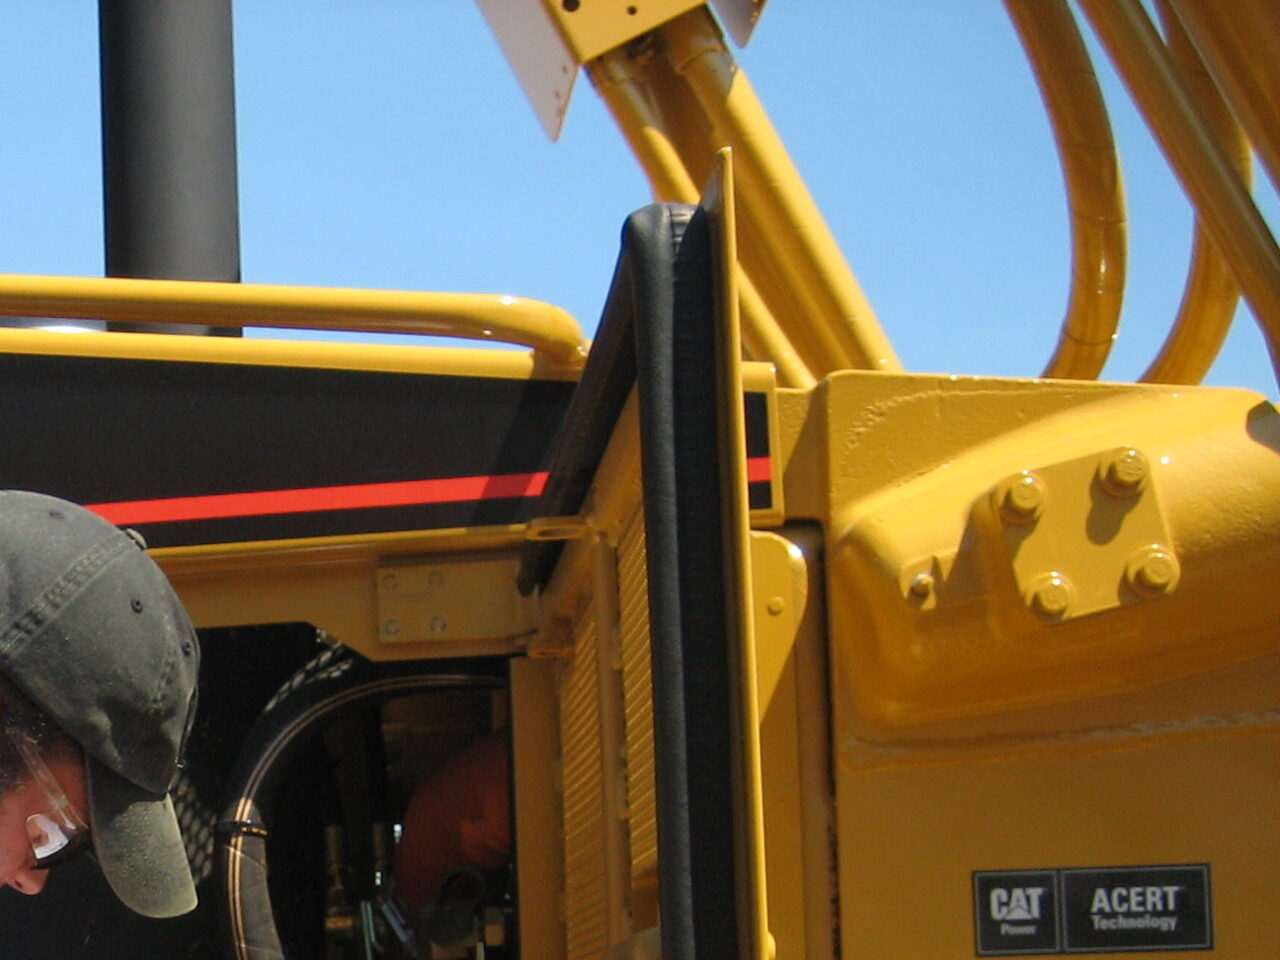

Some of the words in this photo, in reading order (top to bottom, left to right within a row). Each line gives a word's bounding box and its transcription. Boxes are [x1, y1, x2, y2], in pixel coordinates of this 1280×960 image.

[990, 887, 1043, 920] CAT
[1091, 886, 1180, 912] ACERT
[1091, 914, 1177, 931] Technology
